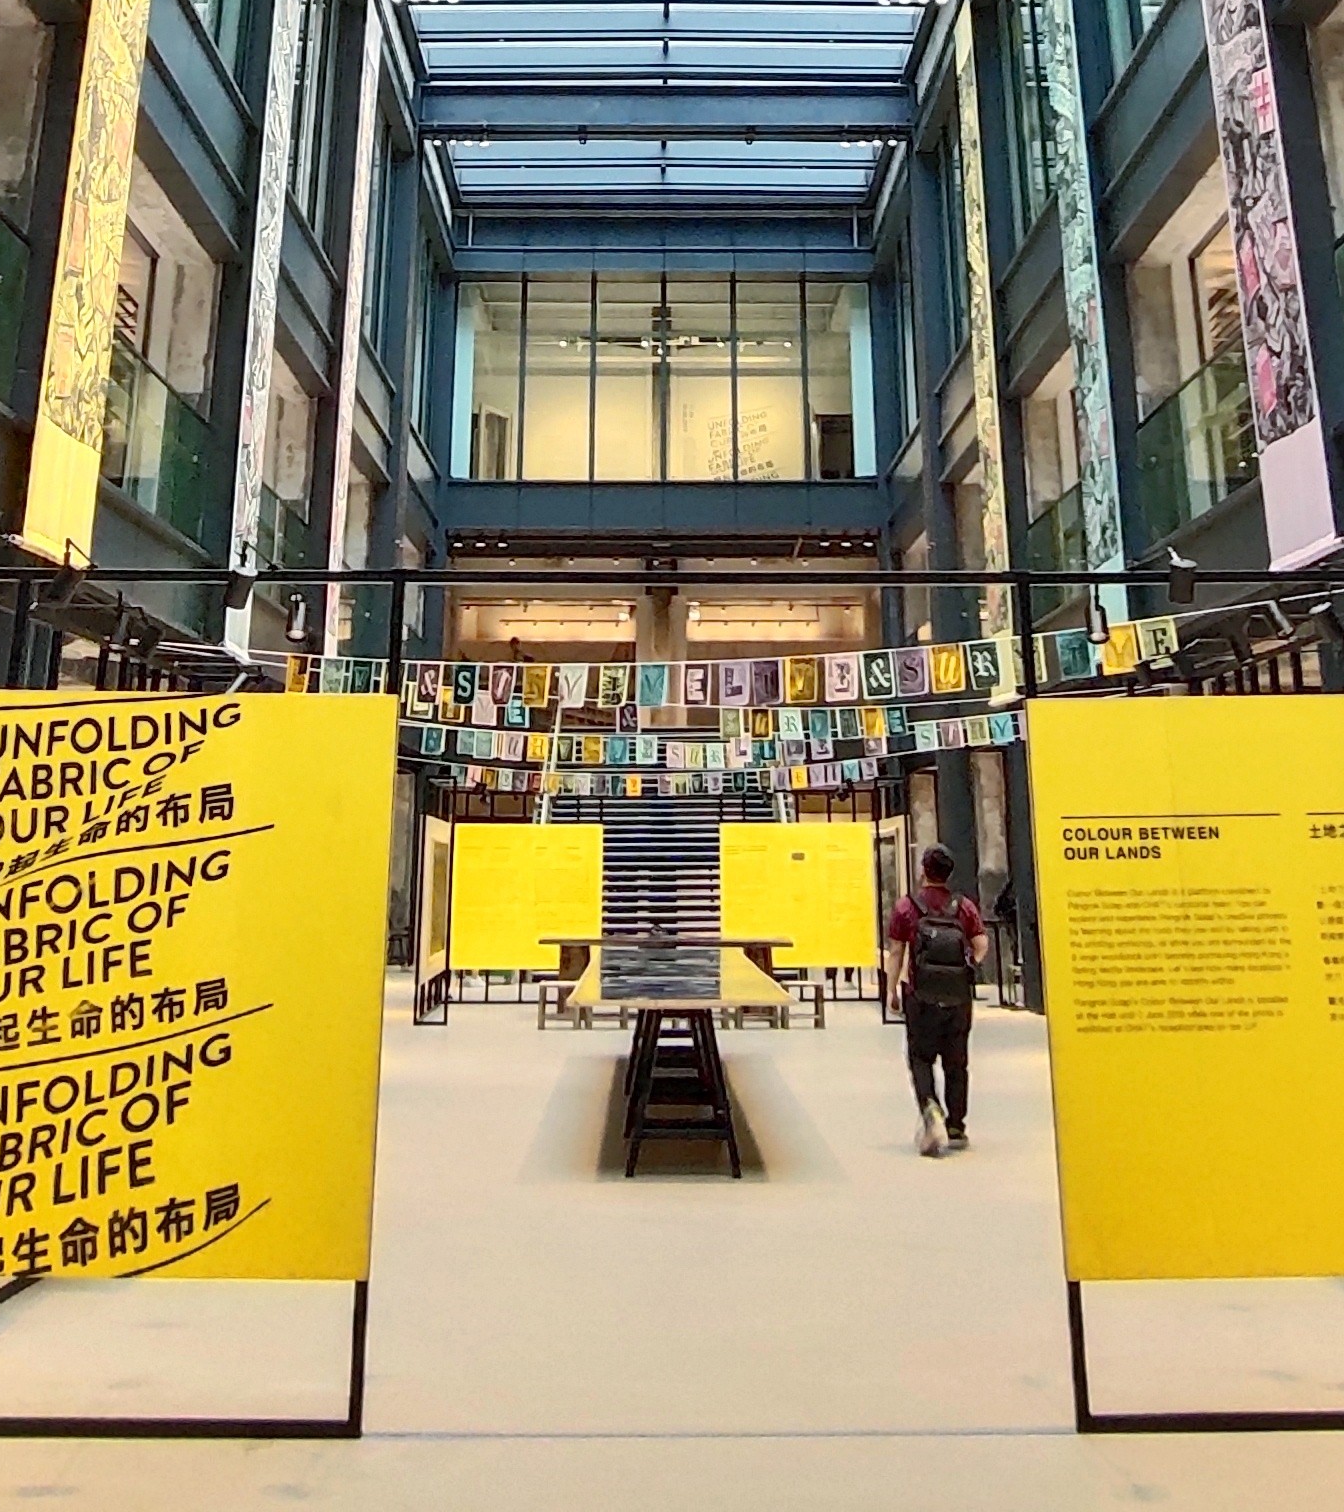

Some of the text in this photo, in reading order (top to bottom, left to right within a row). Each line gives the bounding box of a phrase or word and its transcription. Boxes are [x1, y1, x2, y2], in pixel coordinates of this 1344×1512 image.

[142, 739, 205, 776] OF
[82, 774, 167, 825] LIFE
[1062, 826, 1220, 842] COLOUR BETWEEN
[1063, 845, 1162, 861] OUR LANDS
[127, 893, 190, 934] OF
[62, 939, 153, 989] LIFE
[120, 1080, 192, 1133] OF
[52, 1139, 155, 1206] LIFE
